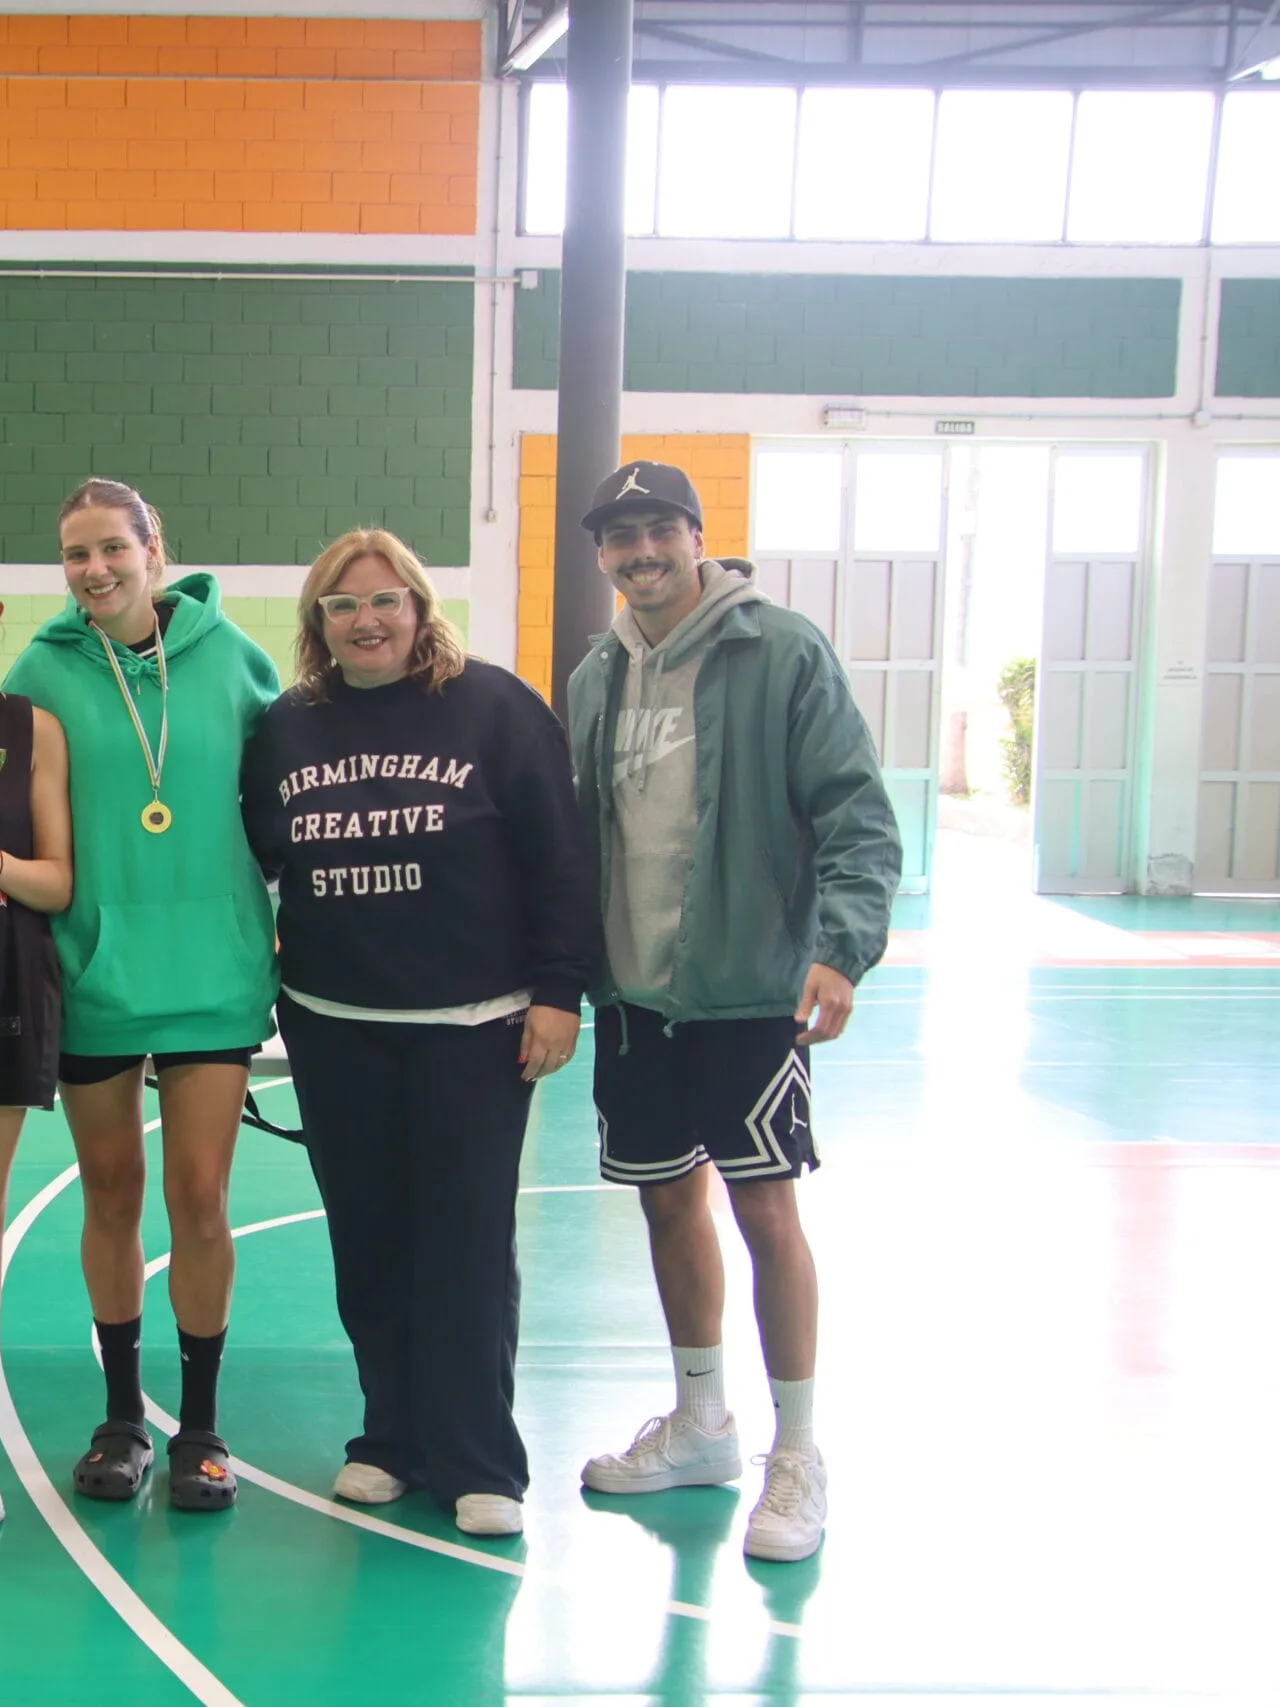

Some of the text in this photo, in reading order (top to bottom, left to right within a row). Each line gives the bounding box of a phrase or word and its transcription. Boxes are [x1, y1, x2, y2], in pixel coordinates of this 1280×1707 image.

[278, 754, 474, 807] BIRMINGHAM
[291, 804, 445, 843] CREATIVE
[312, 862, 422, 897] STUDIO
